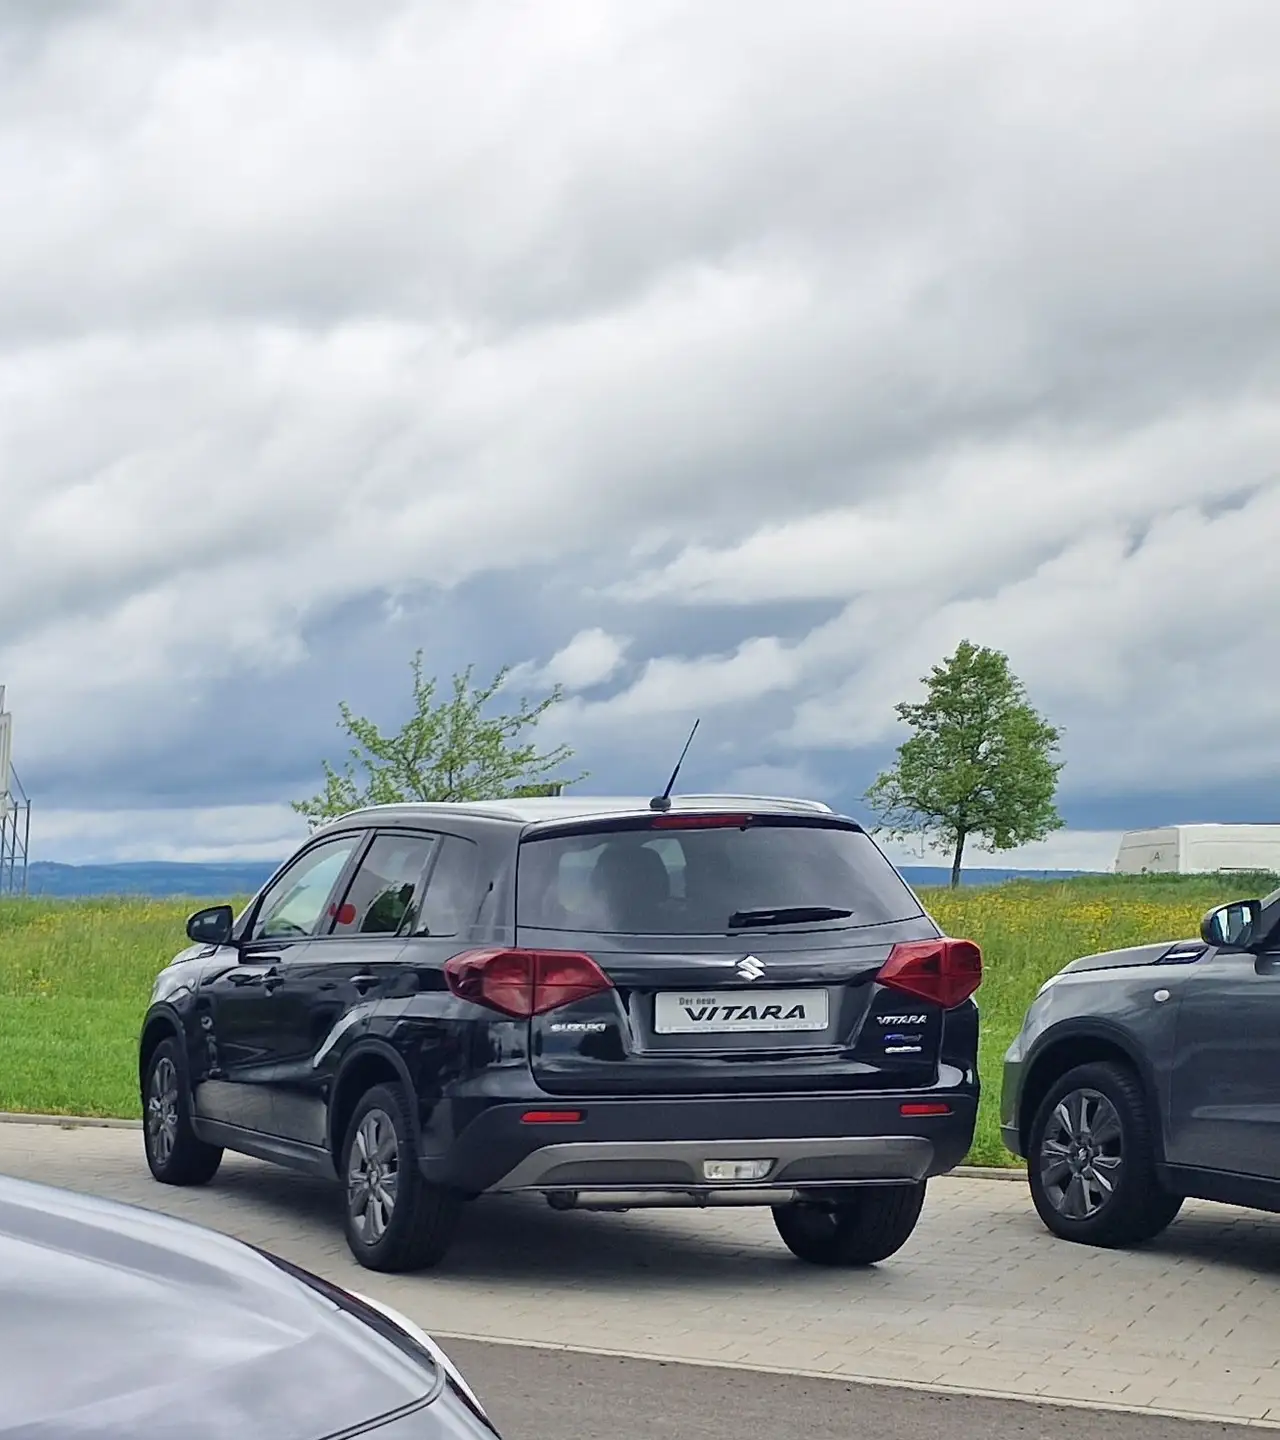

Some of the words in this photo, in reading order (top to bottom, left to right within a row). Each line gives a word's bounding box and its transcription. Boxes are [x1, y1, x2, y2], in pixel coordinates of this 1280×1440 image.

[679, 997, 693, 1006] Der
[684, 1004, 806, 1022] VITARA
[876, 1014, 928, 1025] VITARA
[551, 1022, 607, 1032] SUZUKI
